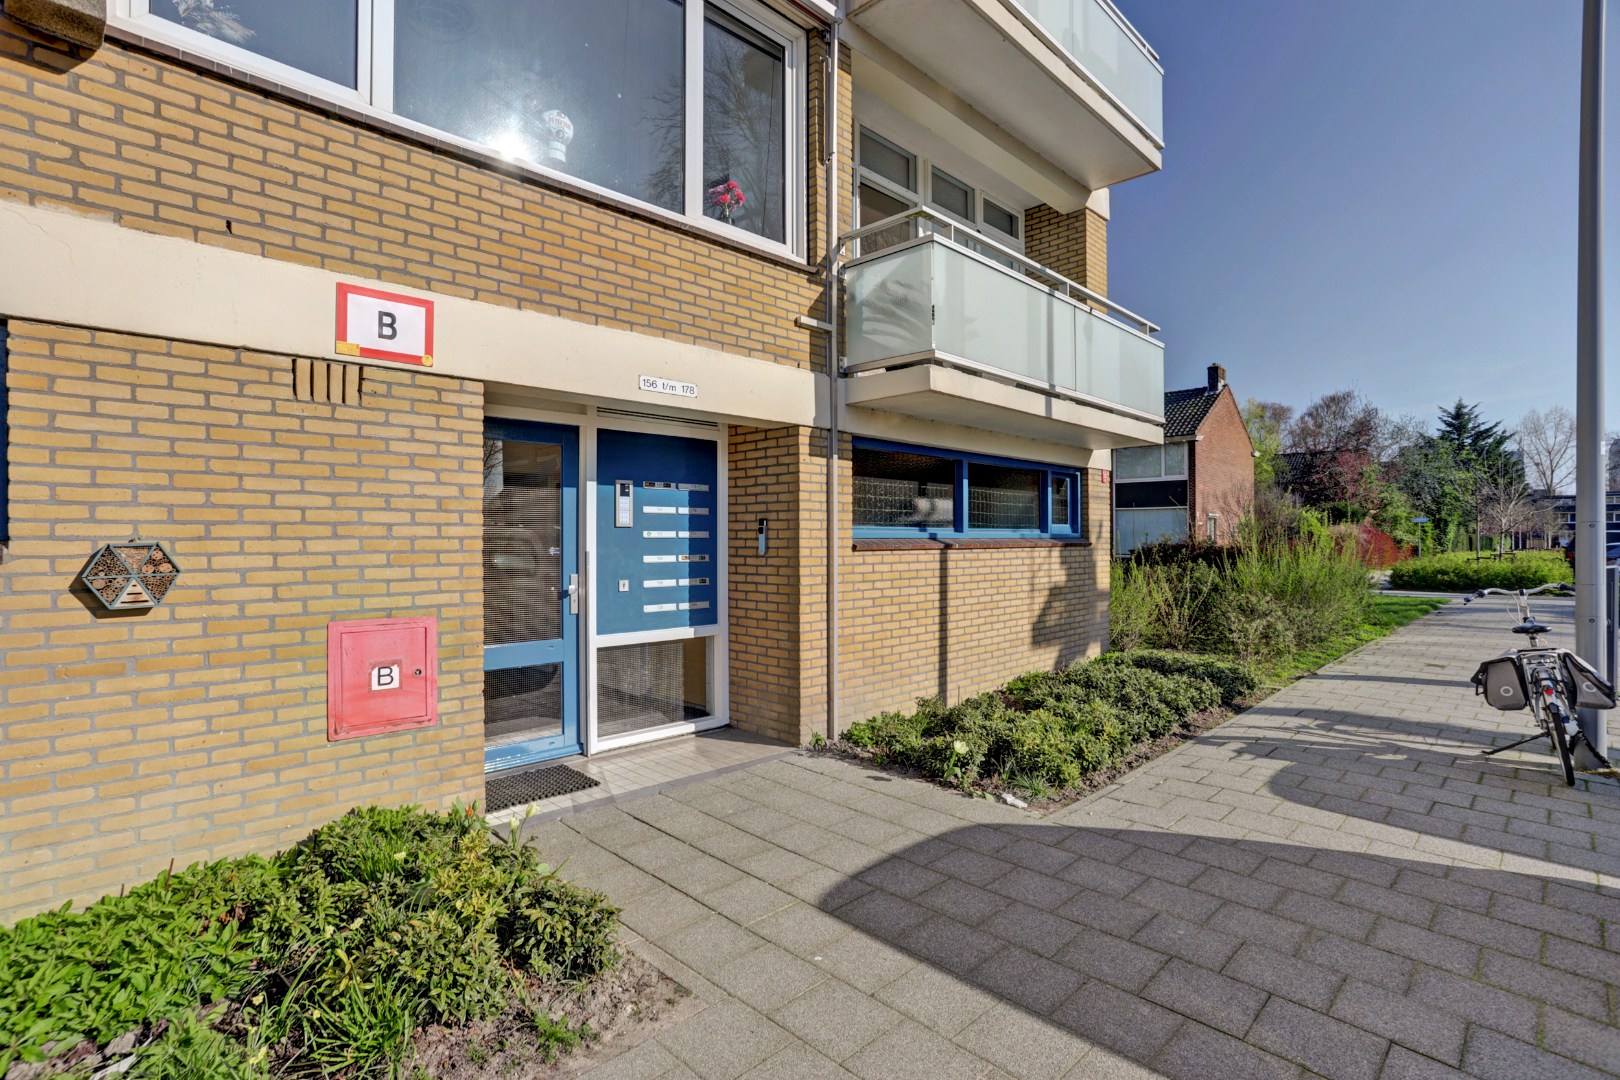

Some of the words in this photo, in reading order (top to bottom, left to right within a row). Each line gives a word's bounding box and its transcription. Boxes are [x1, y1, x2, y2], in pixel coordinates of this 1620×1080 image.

[378, 310, 398, 341] B
[642, 378, 658, 389] 156
[662, 381, 677, 392] t/m
[681, 384, 695, 395] 178
[377, 666, 394, 687] B
